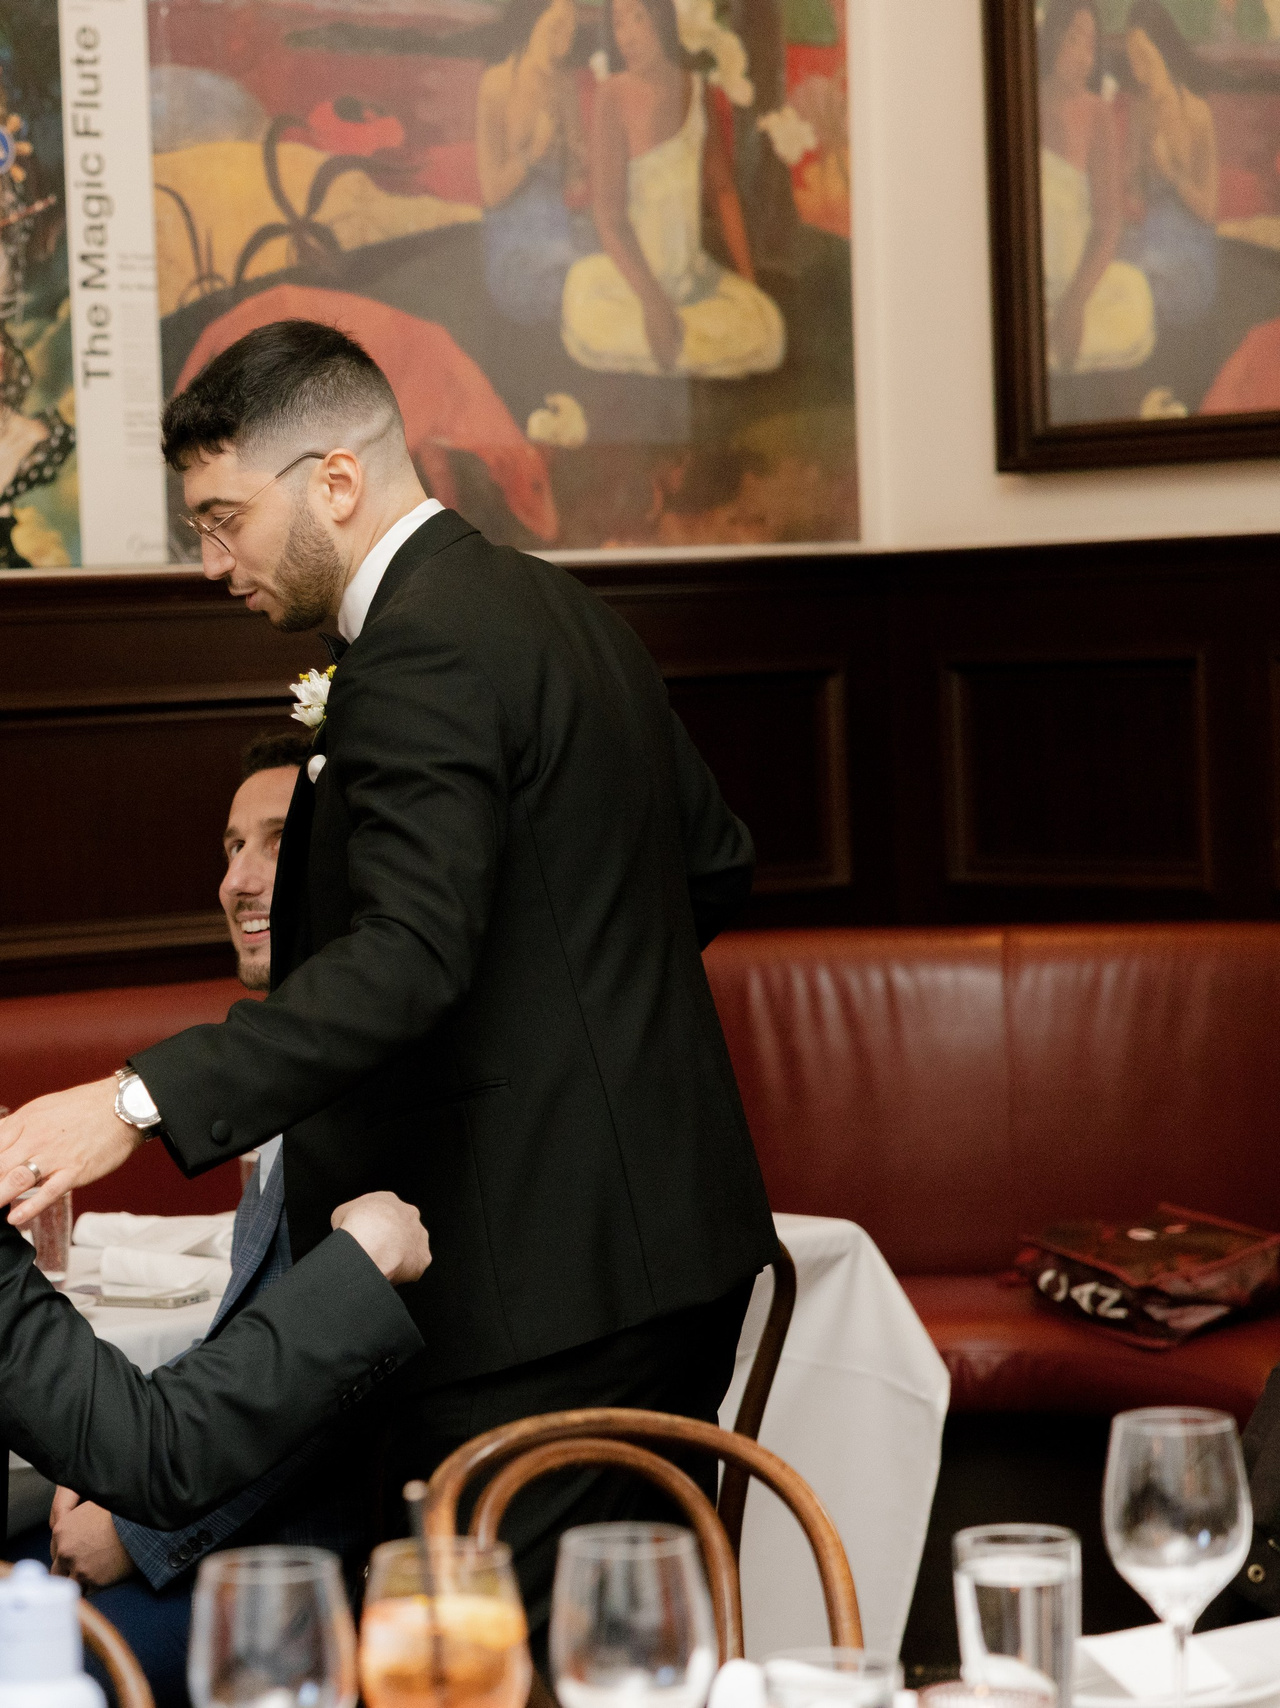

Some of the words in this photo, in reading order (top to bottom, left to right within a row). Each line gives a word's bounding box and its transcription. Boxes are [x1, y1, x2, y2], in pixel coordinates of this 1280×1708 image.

[71, 24, 102, 141] Flute
[74, 145, 114, 294] Magic
[83, 302, 114, 391] The
